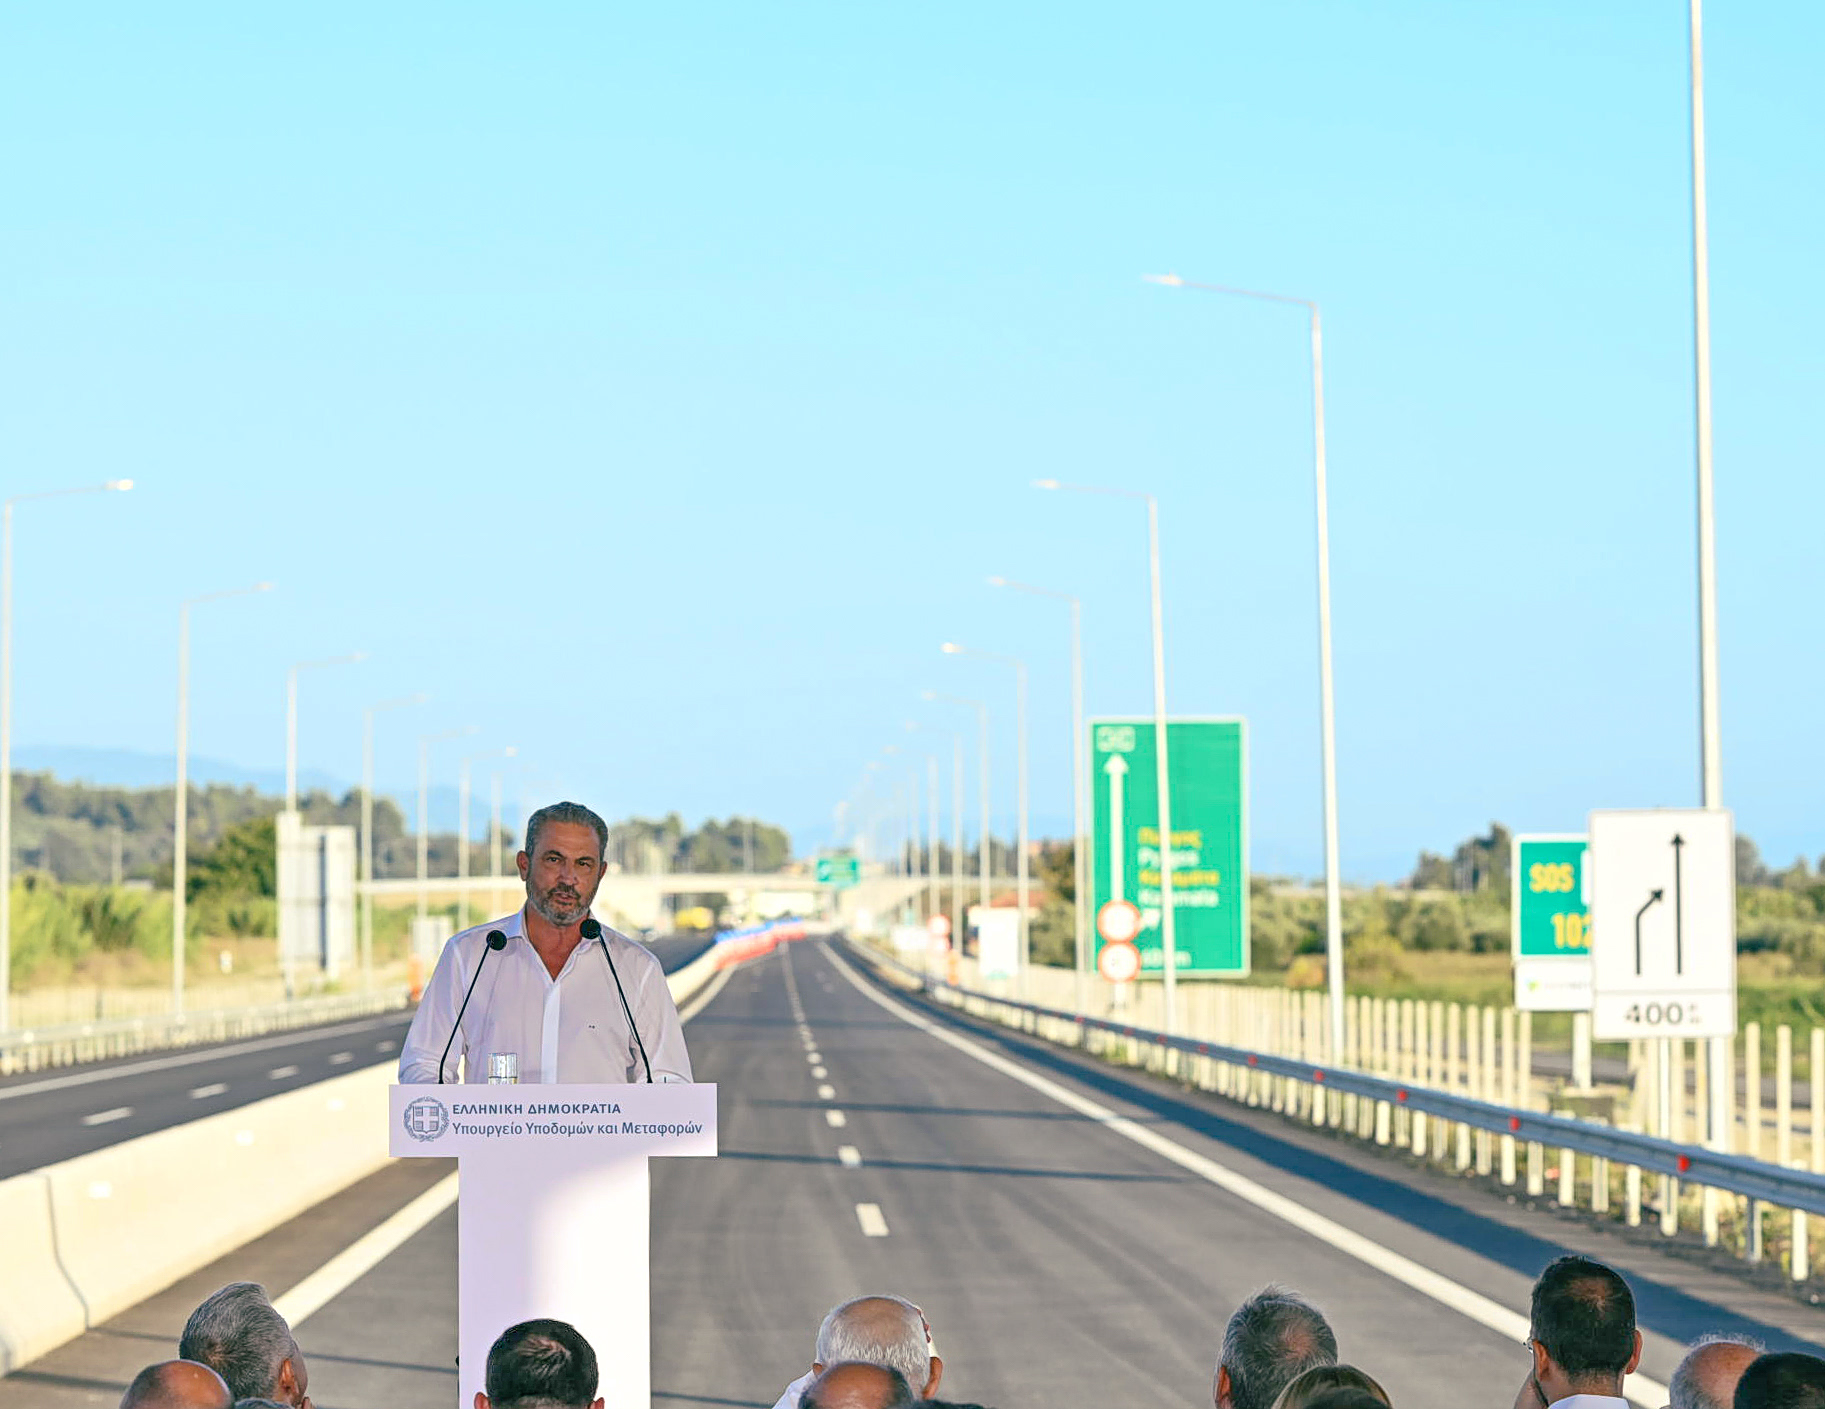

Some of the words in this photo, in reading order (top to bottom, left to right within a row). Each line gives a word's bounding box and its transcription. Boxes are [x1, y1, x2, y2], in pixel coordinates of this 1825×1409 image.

[1530, 863, 1574, 892] SOS
[452, 1103, 523, 1115] ΕΛΛΗΝΙΚΗ
[527, 1103, 622, 1115] ΔΗΜΟΚΡΑΤΙΑ
[452, 1121, 523, 1138] Υπουργείο
[526, 1121, 595, 1138] Υποδομών
[597, 1124, 618, 1136] και
[621, 1121, 703, 1138] Μεταφορών
